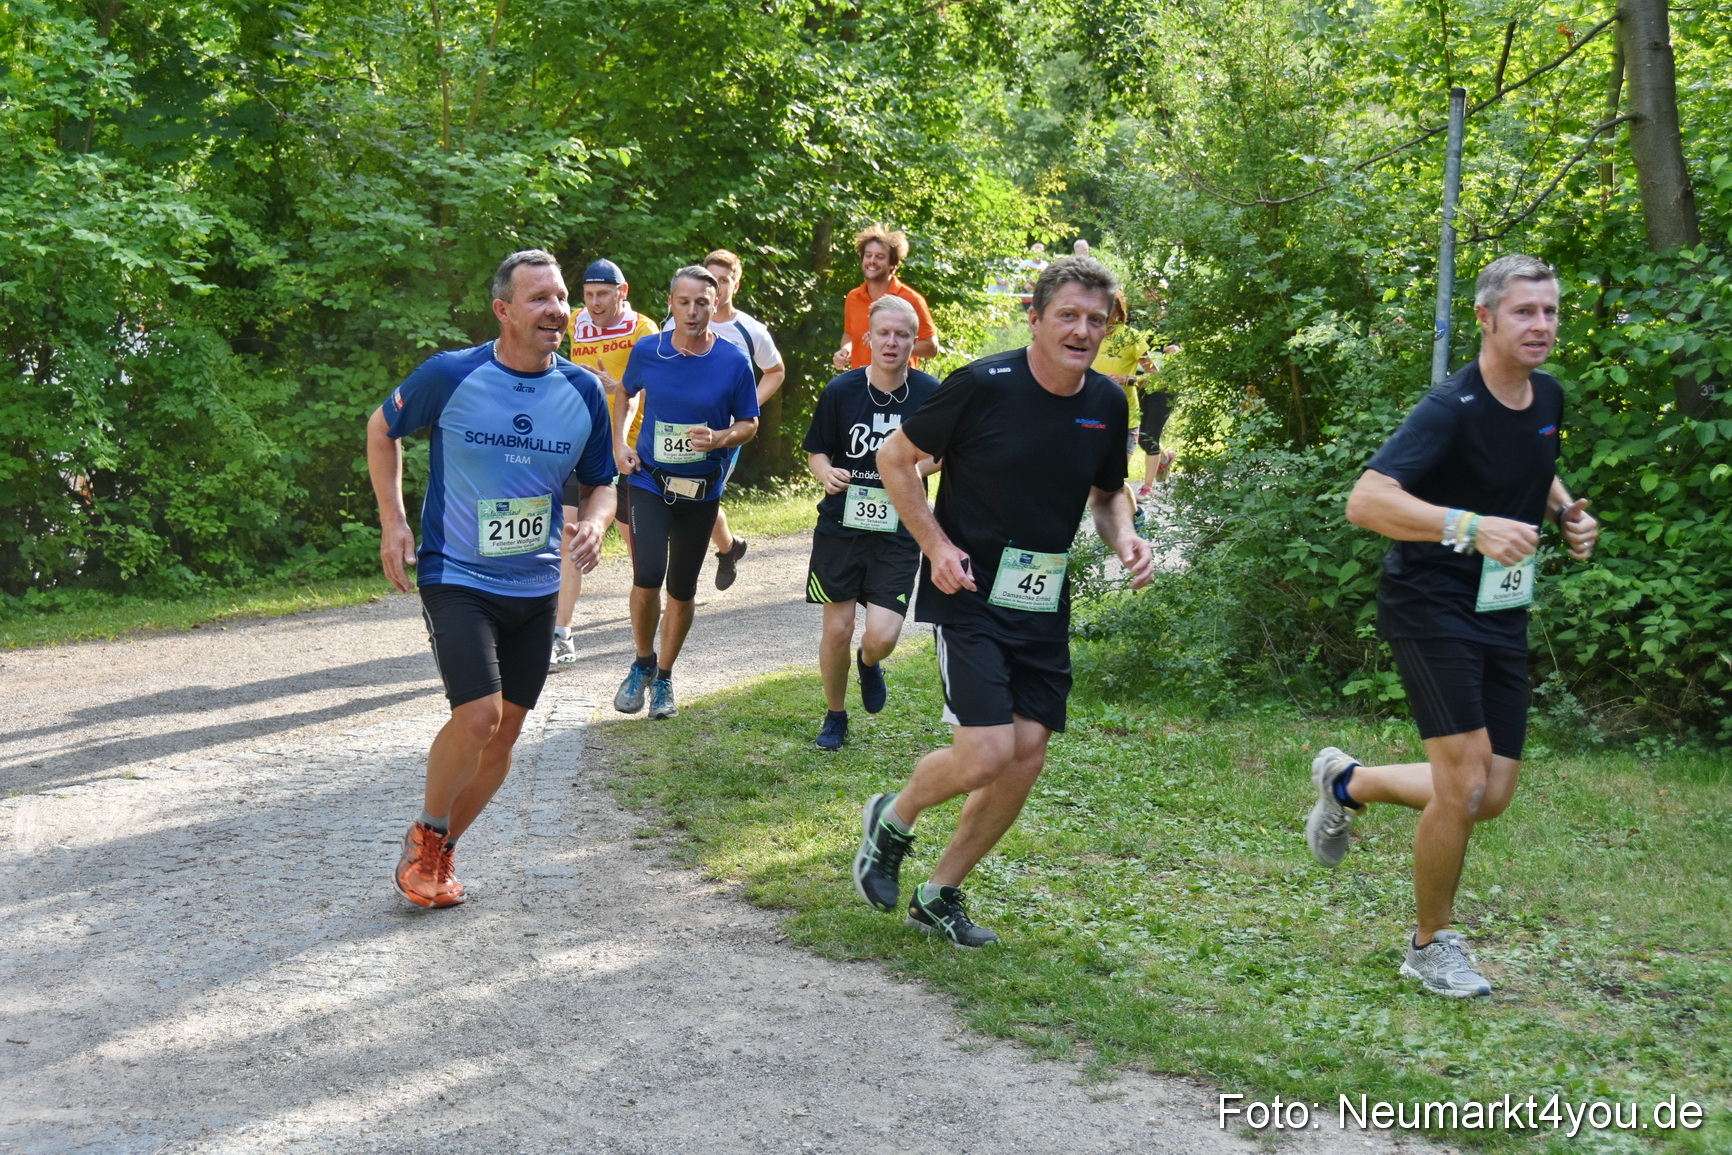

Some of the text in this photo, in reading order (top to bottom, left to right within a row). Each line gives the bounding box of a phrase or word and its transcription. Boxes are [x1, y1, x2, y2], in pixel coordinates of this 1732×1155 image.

[572, 339, 635, 357] MAX BÖGL
[464, 430, 572, 455] SCHABMÜLLER
[664, 437, 693, 453] 849
[845, 423, 884, 458] Bu
[504, 453, 531, 465] TEAM
[851, 469, 881, 480] Knöde
[856, 501, 888, 520] 393
[488, 515, 543, 541] 2106
[516, 537, 541, 545] Wolfgang
[1017, 573, 1047, 596] 45
[1500, 569, 1522, 592] 49
[1002, 590, 1035, 601] Damaschke
